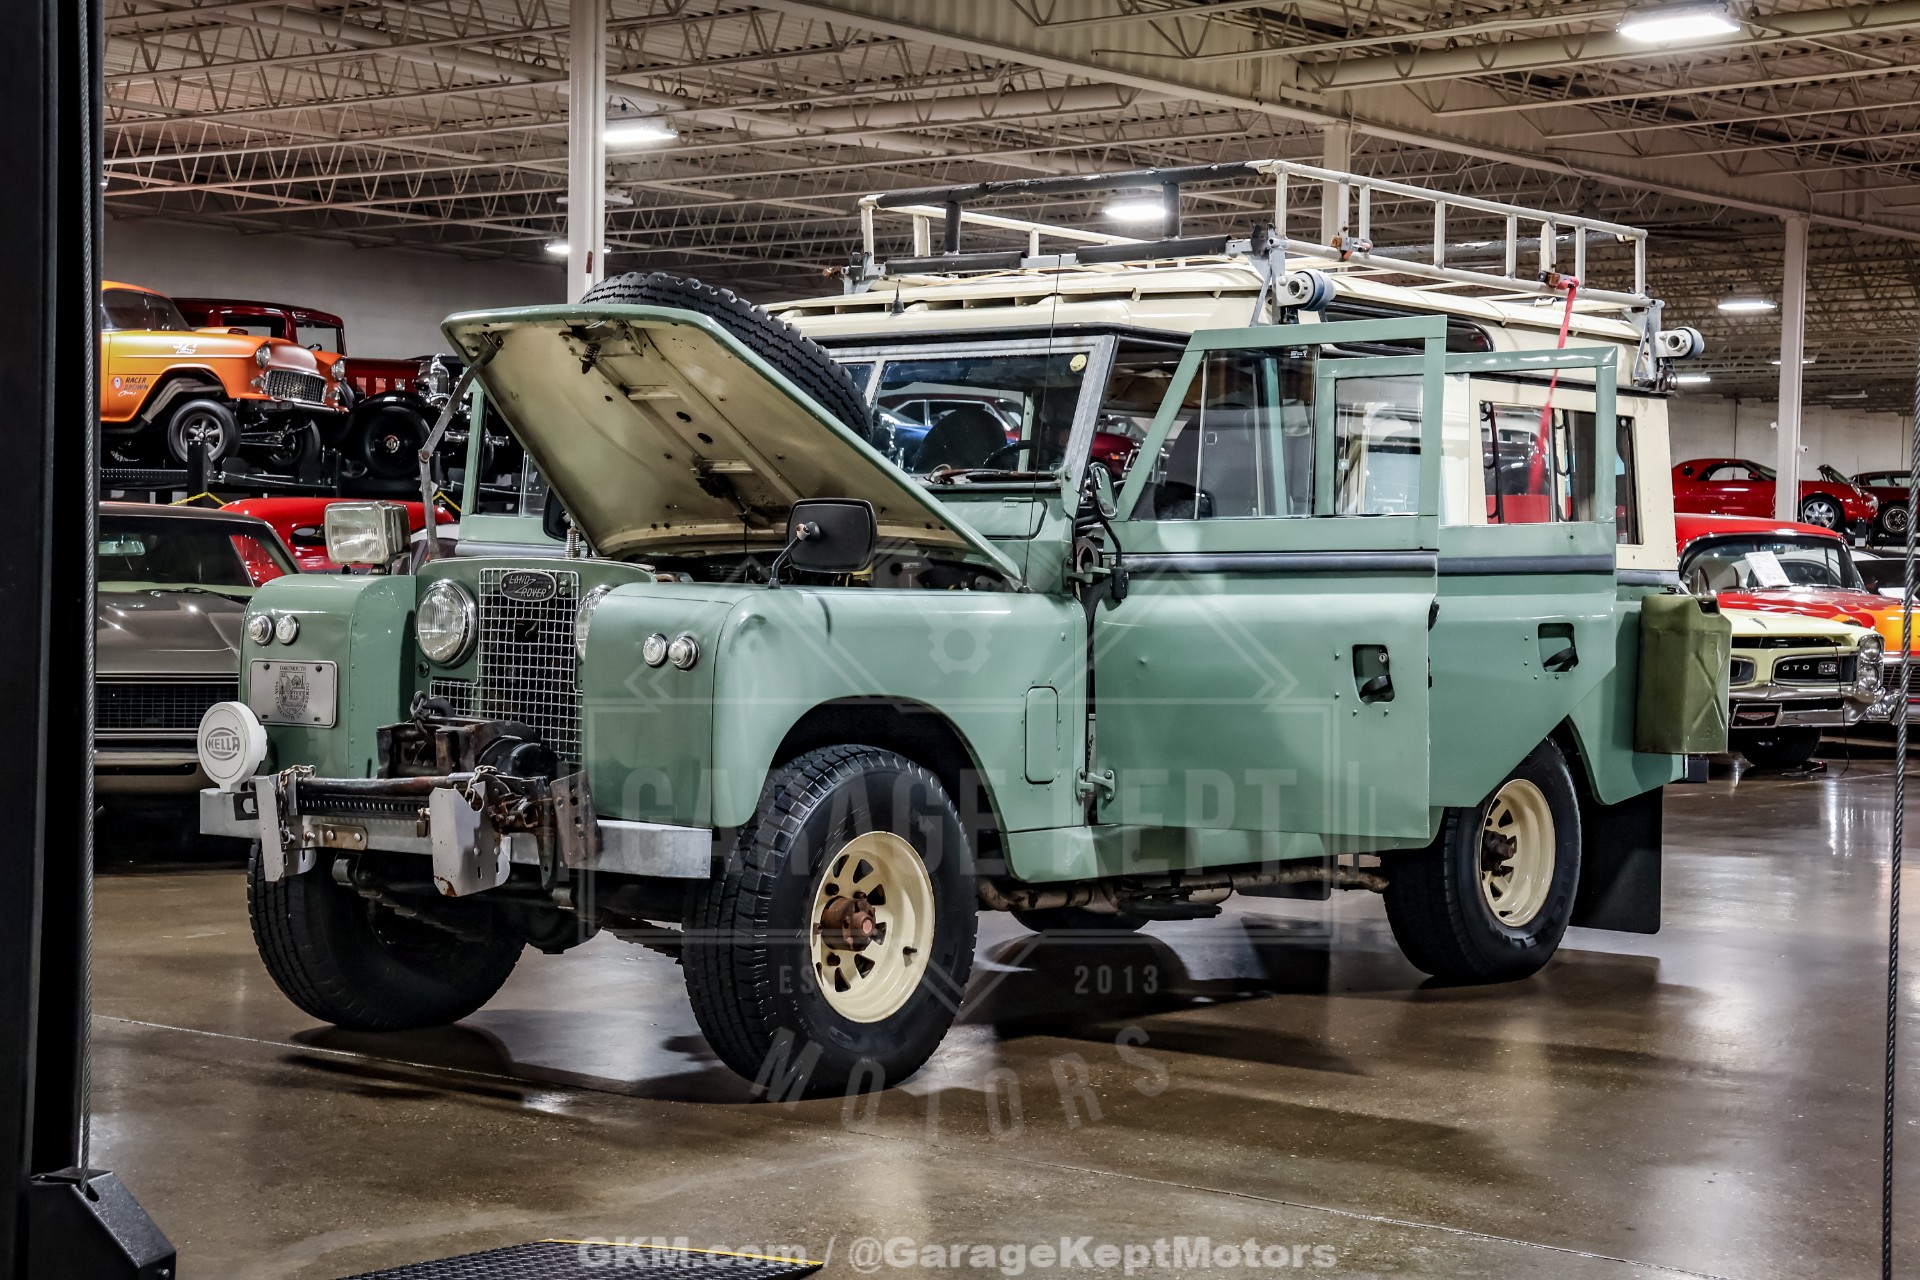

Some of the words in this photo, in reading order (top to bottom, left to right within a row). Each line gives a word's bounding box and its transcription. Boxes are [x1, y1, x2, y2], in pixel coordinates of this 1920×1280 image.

[124, 383, 149, 391] BROWN
[509, 575, 530, 585] LAND
[520, 588, 547, 598] ROVER
[208, 736, 241, 752] HELLA
